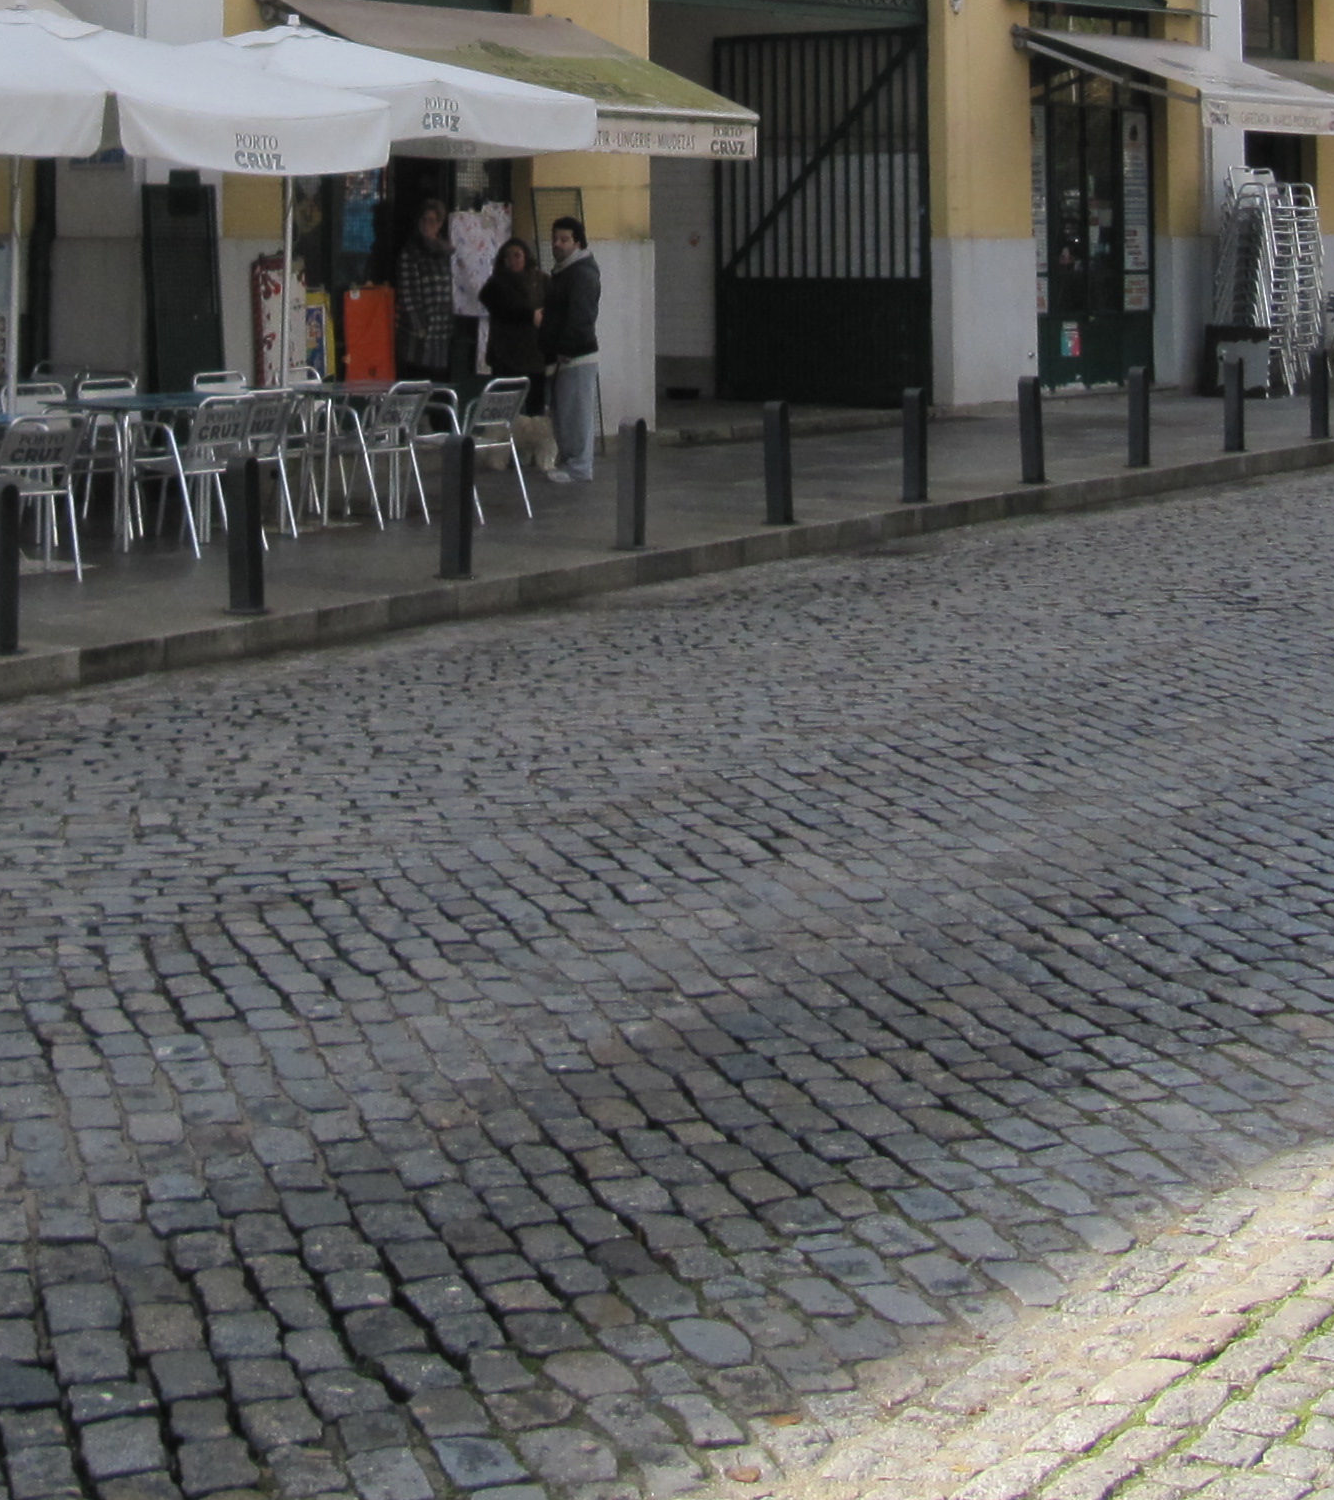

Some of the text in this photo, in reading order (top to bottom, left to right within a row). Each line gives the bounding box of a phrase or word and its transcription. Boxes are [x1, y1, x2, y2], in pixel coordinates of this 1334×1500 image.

[711, 123, 743, 138] PORTO
[235, 133, 279, 151] PORTO
[709, 139, 746, 156] CRUZ
[234, 150, 286, 171] CRUZ
[18, 433, 66, 446] PORTO
[198, 422, 241, 440] CRUZ
[9, 446, 64, 463] CRUZ
